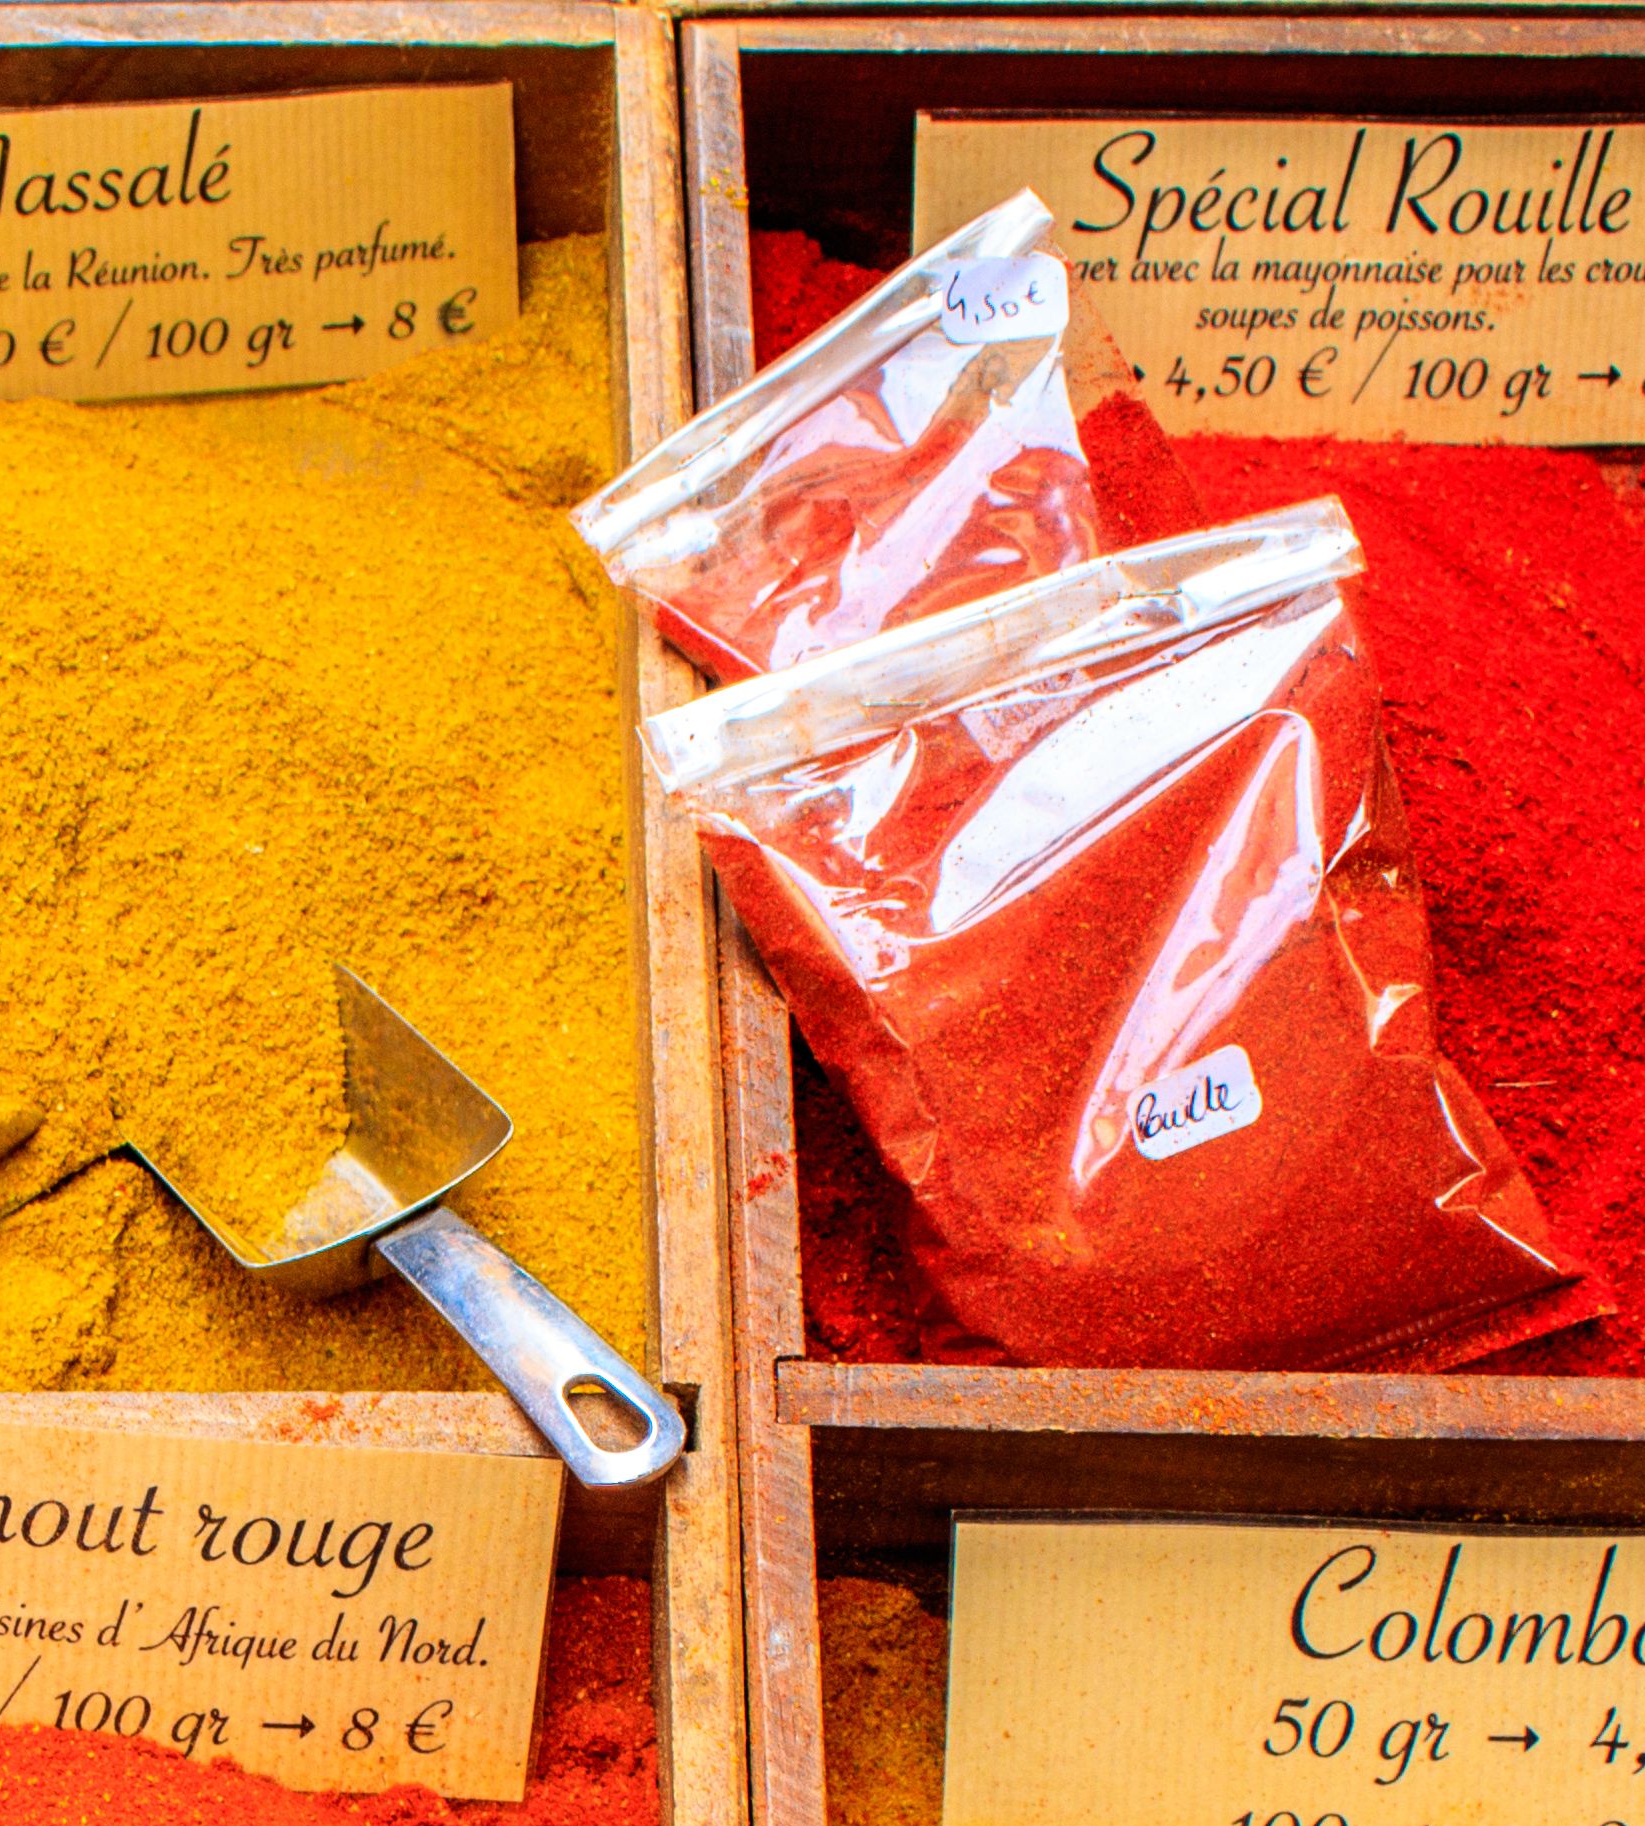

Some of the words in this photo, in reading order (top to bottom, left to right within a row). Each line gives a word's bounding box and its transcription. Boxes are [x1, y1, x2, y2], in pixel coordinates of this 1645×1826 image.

[1072, 129, 1367, 259] Spécial
[1386, 130, 1633, 238] Rouille
[24, 246, 52, 291] la
[66, 243, 210, 287] Réunion.
[226, 233, 302, 280] Très
[313, 220, 457, 279] parfumé.
[1130, 258, 1200, 283] avec
[1211, 235, 1240, 283] la
[1252, 254, 1443, 293] mayonnaise
[1452, 255, 1526, 295] pour
[1539, 239, 1577, 284] les
[39, 320, 77, 366] €
[146, 317, 228, 359] 100
[247, 314, 296, 366] gr
[389, 301, 416, 339] 8
[437, 288, 478, 335] €
[1196, 303, 1297, 339] soupes
[1310, 287, 1345, 330] de
[1355, 303, 1495, 339] poissons.
[1164, 356, 1276, 403] 4,50
[1295, 345, 1339, 397] €
[1405, 358, 1488, 399] 100
[1504, 360, 1554, 416] gr
[193, 1506, 435, 1598] rouge
[311, 1615, 361, 1663] du
[377, 1617, 491, 1668] Nord.
[55, 1688, 152, 1736] 100
[172, 1711, 233, 1759] gr
[341, 1704, 379, 1753] 8
[405, 1700, 454, 1755] €
[1262, 1698, 1354, 1758] 50
[1375, 1711, 1451, 1785] gr
